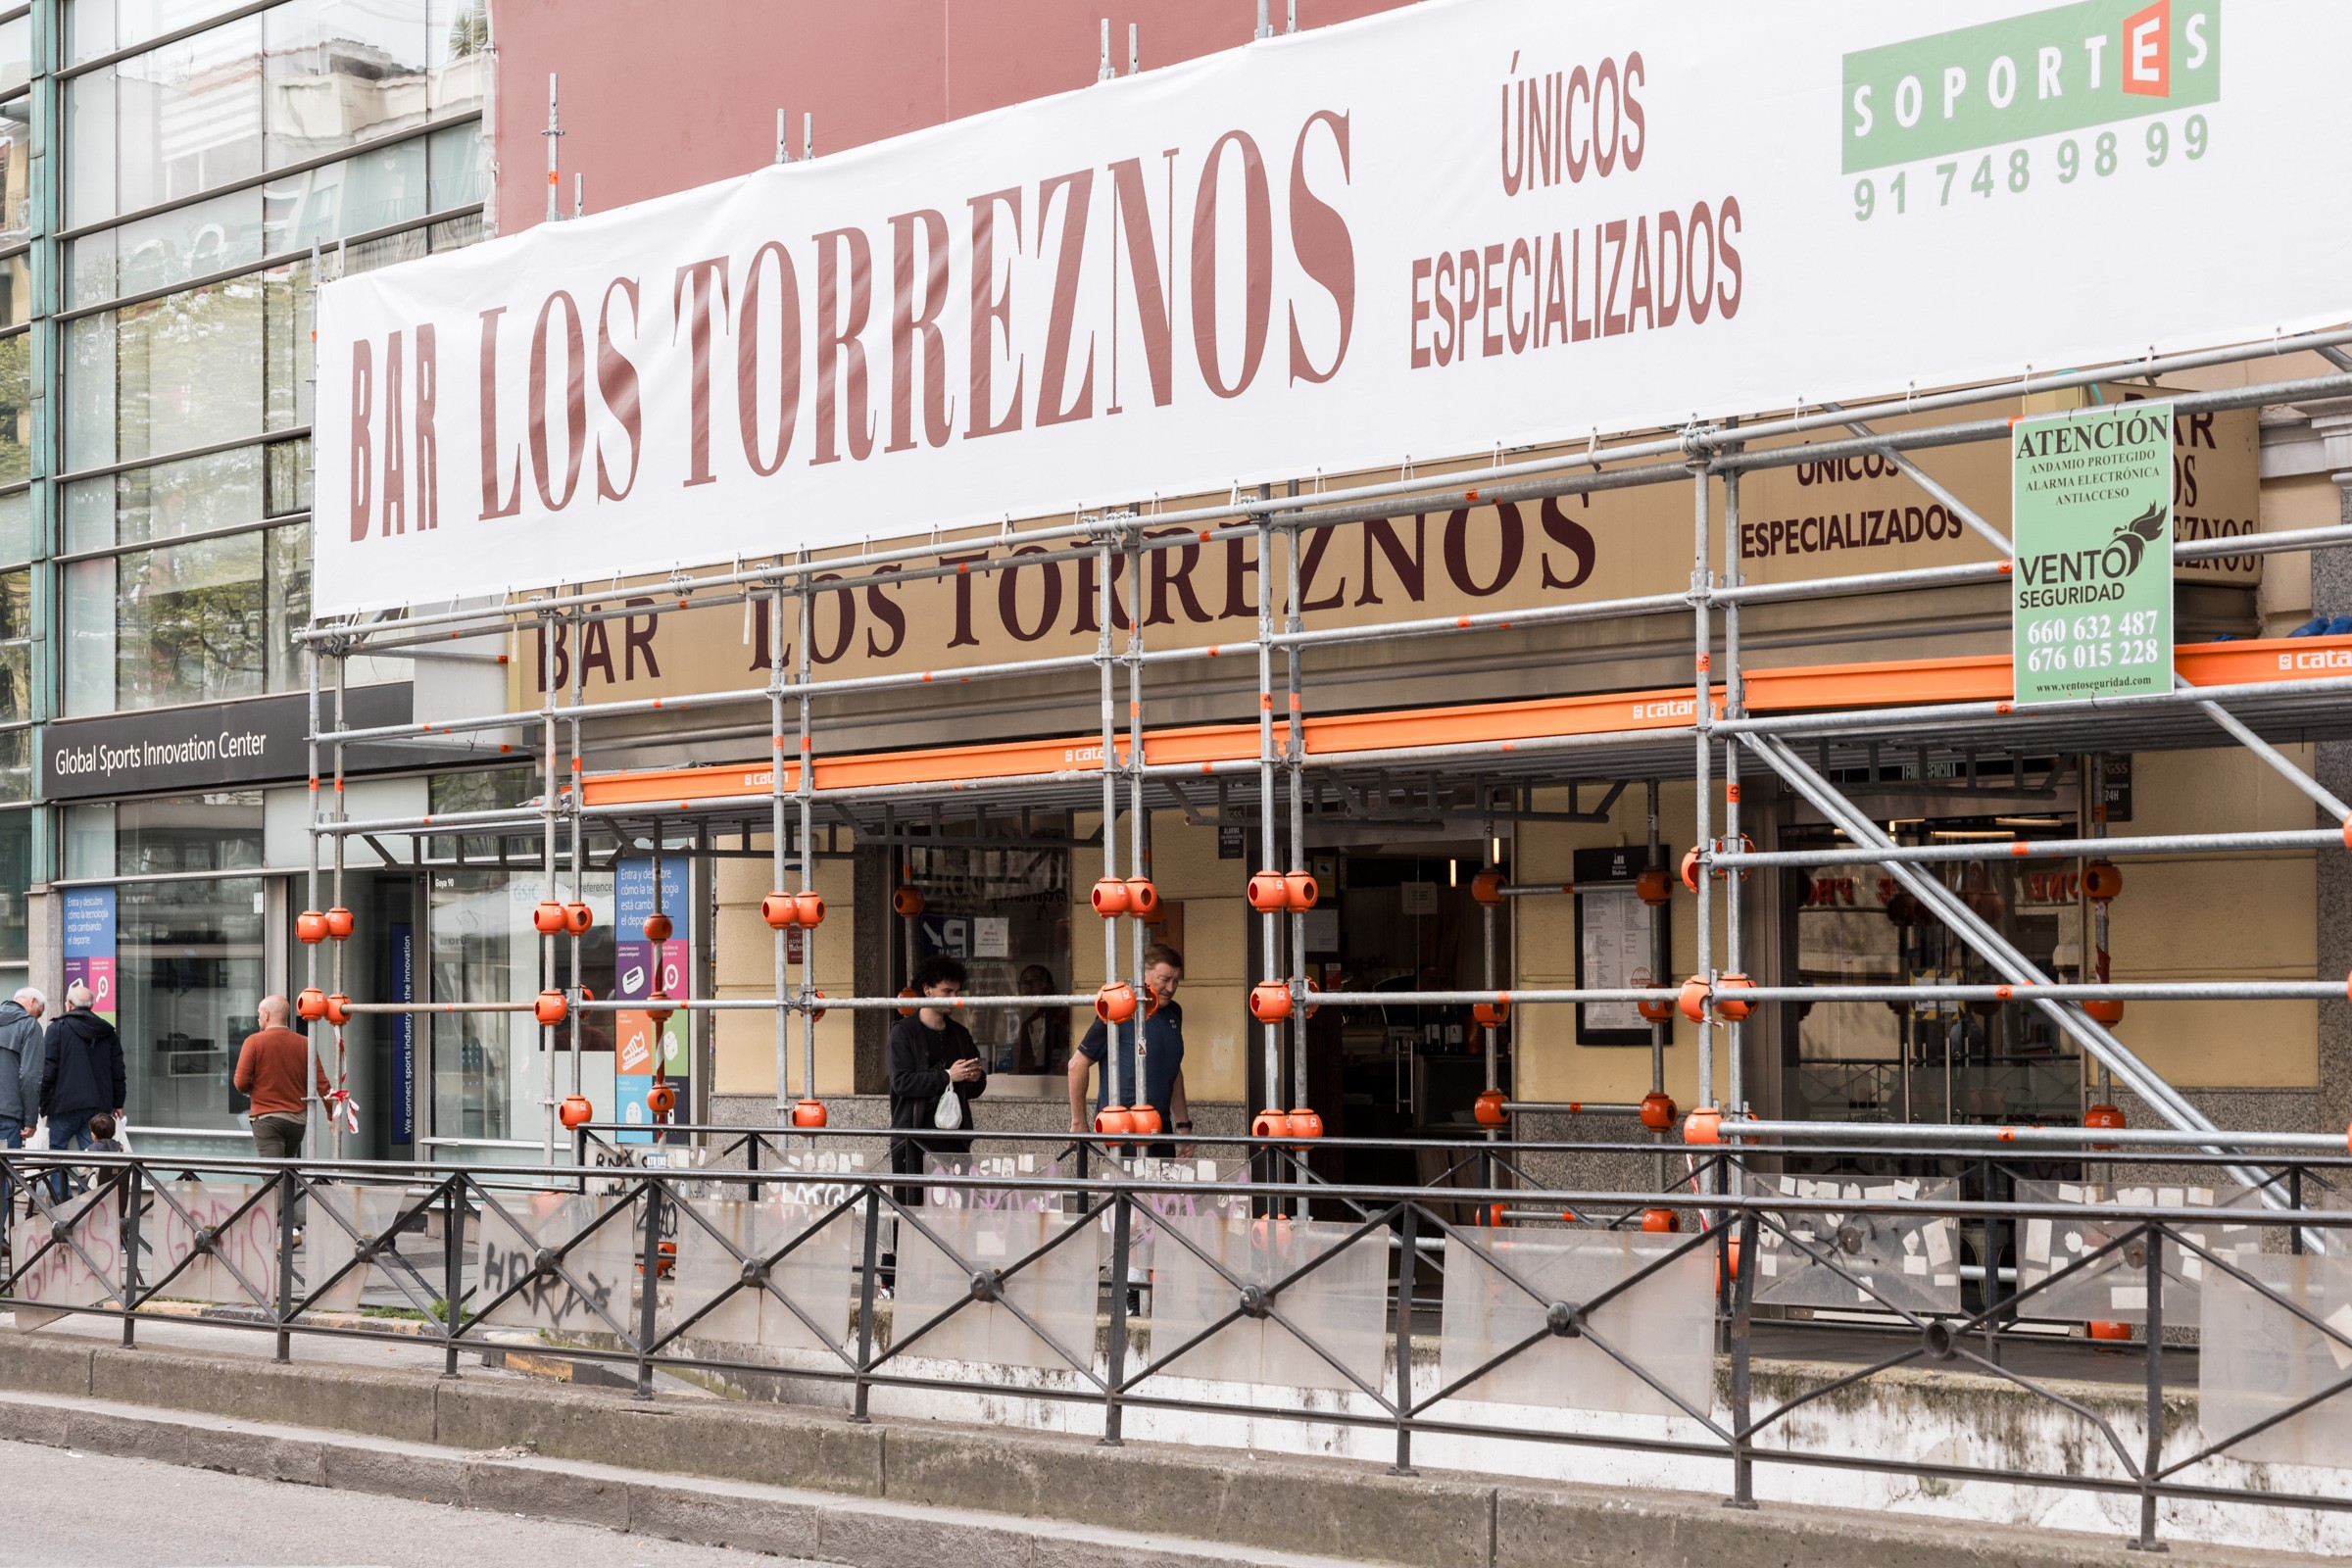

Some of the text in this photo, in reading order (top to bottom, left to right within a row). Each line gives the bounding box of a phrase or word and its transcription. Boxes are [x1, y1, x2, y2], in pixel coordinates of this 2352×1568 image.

[1854, 11, 2208, 139] SOPORTES
[1501, 51, 1645, 197] ÚNICOS
[1853, 114, 2210, 222] 91 748 98 99
[1410, 196, 1742, 369] ESPECIALIZADOS
[350, 108, 1356, 543] BAR LOS TORREZNOS
[2016, 410, 2170, 459] ATENCIÓN
[2030, 449, 2156, 474] ANDAMIO PROTEGIDO
[2026, 466, 2160, 492] ALARMA ELECTRÓNICA
[2055, 487, 2130, 506] ANTIACCESO
[1740, 504, 1963, 559] ESPECIALIZADOS
[2019, 547, 2127, 586] VENTO
[2019, 582, 2126, 609] SEGURIDAD
[538, 597, 661, 692] BAR
[749, 564, 906, 672] LOS
[2028, 610, 2159, 645] 660 632 487
[2028, 638, 2159, 672] 676 015 228
[2297, 650, 2352, 669] cata
[2036, 675, 2152, 693] www.ventoseguridad.com
[1646, 699, 1697, 718] catar
[55, 731, 267, 777] Global Sports Innovation Center
[435, 878, 455, 889] Goya 90
[621, 869, 637, 880] Entra
[643, 868, 671, 880] desbre
[68, 898, 79, 906] Entra
[83, 897, 103, 906] descubre
[514, 883, 539, 903] GSIC
[621, 885, 638, 895] cómo
[639, 884, 646, 894] la
[621, 900, 633, 911] está
[621, 915, 626, 925] el
[403, 935, 412, 983] innovation
[403, 1012, 413, 1053] industry
[404, 1054, 413, 1079] sports
[404, 1119, 412, 1134] We
